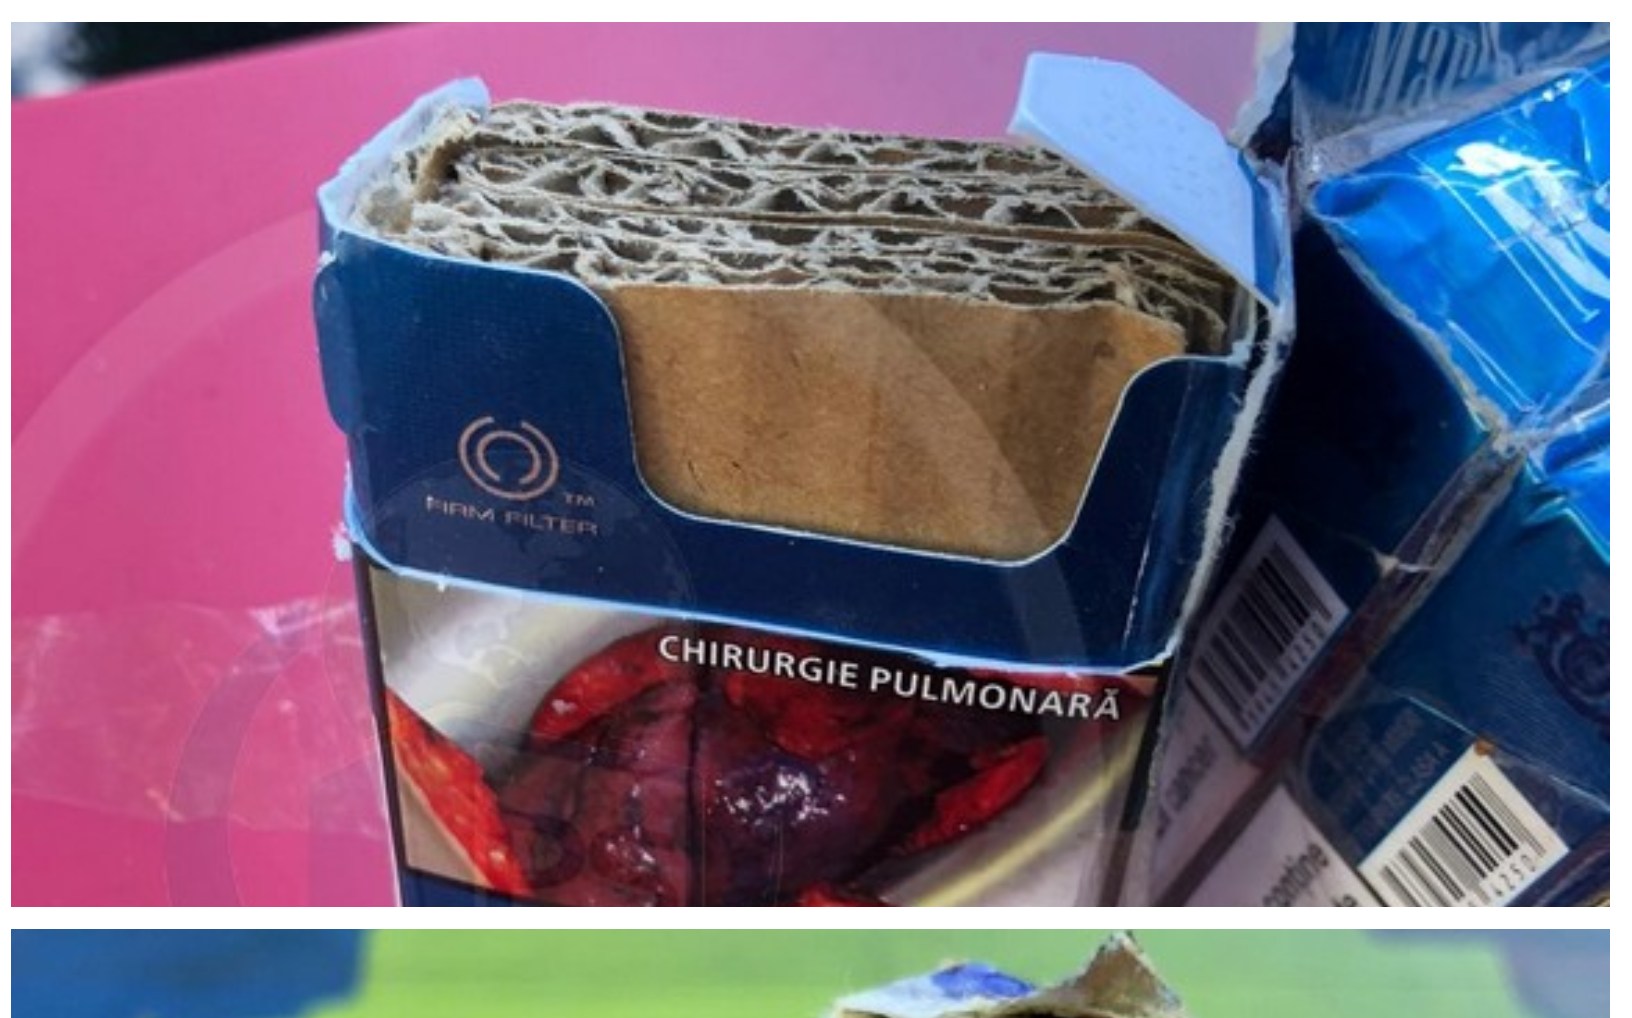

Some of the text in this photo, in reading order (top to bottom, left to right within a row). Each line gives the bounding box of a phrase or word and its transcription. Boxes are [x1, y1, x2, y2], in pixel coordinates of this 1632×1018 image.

[426, 496, 599, 537] FIRM FILTER
[658, 635, 1121, 722] CHIRURGIE PULMONARĂ
